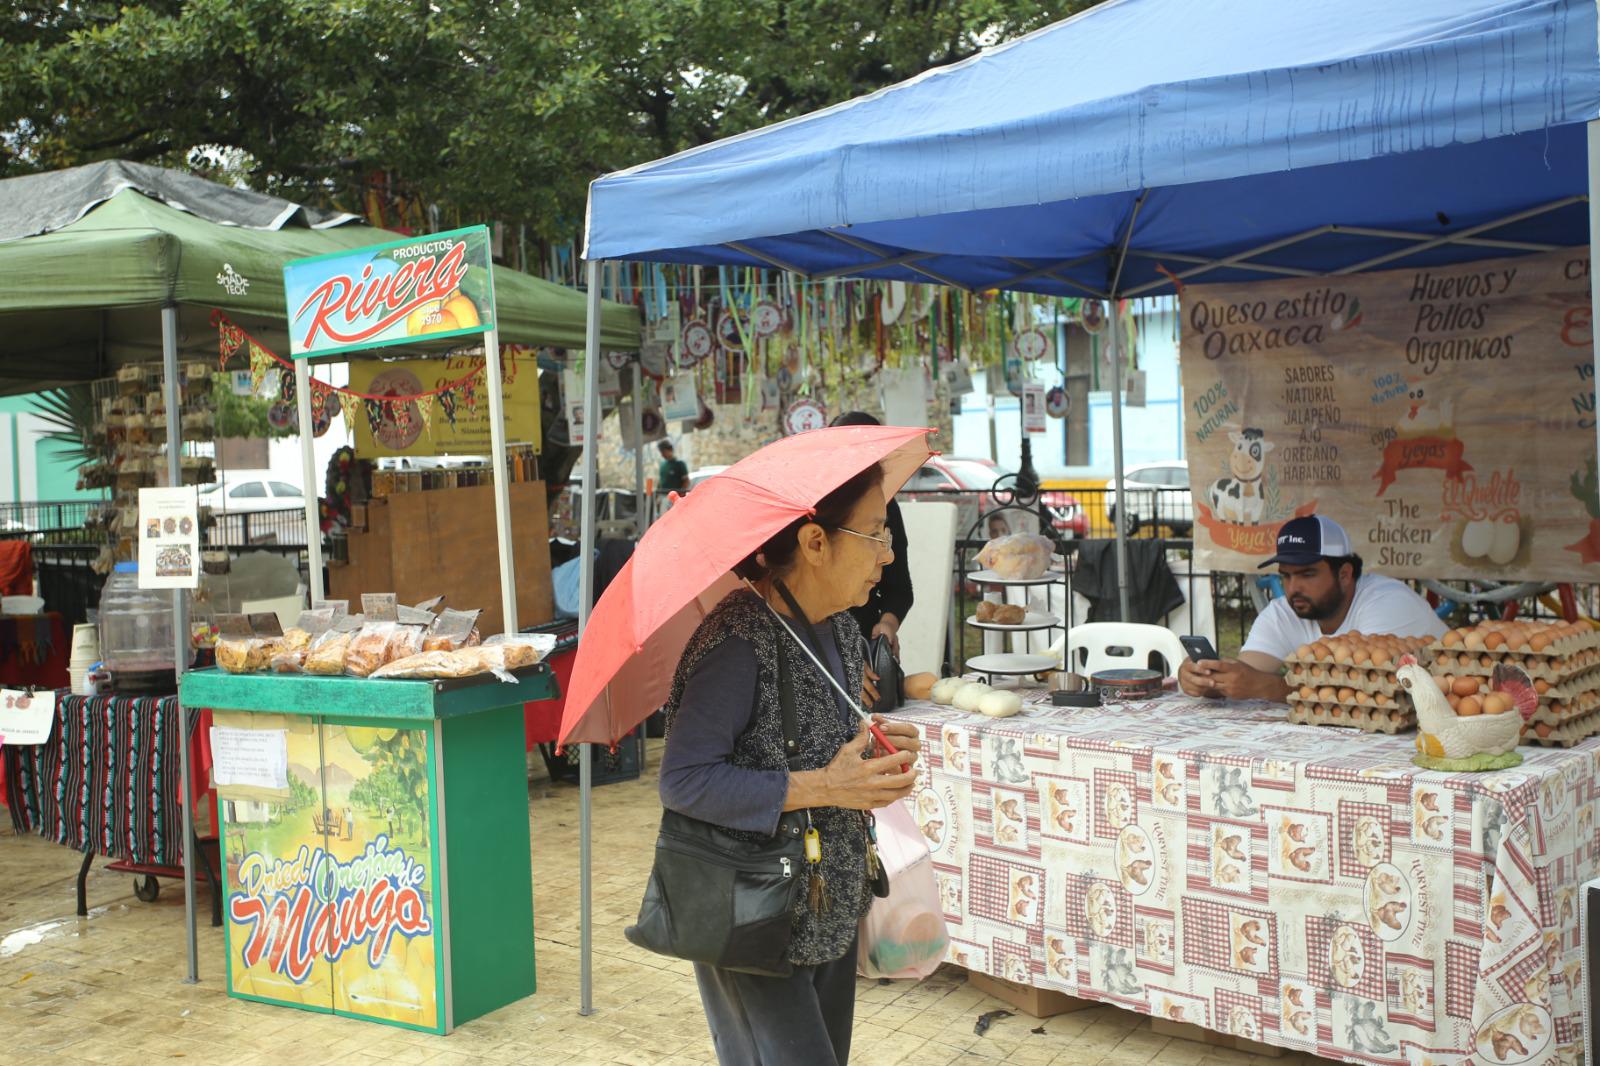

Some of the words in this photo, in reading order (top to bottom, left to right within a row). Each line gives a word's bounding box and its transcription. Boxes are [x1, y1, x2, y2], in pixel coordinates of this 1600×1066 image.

[393, 239, 453, 260] PRODUCTOS
[294, 236, 468, 349] Rivera
[1409, 271, 1496, 302] Huevos
[1190, 300, 1267, 335] Queso
[1274, 288, 1347, 321] estilo
[1414, 301, 1490, 333] Pollos
[1203, 323, 1324, 360] Oaxaca
[1406, 335, 1513, 376] Organicos
[1284, 364, 1335, 384] SABORES
[1193, 380, 1228, 419] 100%
[1285, 387, 1337, 403] NATURAL
[1196, 399, 1240, 444] NATURAL
[1283, 405, 1341, 425] JALAPEÑO
[1299, 429, 1322, 443] AJO
[1282, 447, 1338, 463] OREGANO
[1283, 464, 1341, 481] HABANERO
[1384, 499, 1420, 519] The
[1288, 535, 1306, 544] Inc.
[1378, 546, 1422, 566] Store
[1409, 858, 1428, 915] HARVEST
[232, 878, 430, 979] Mango
